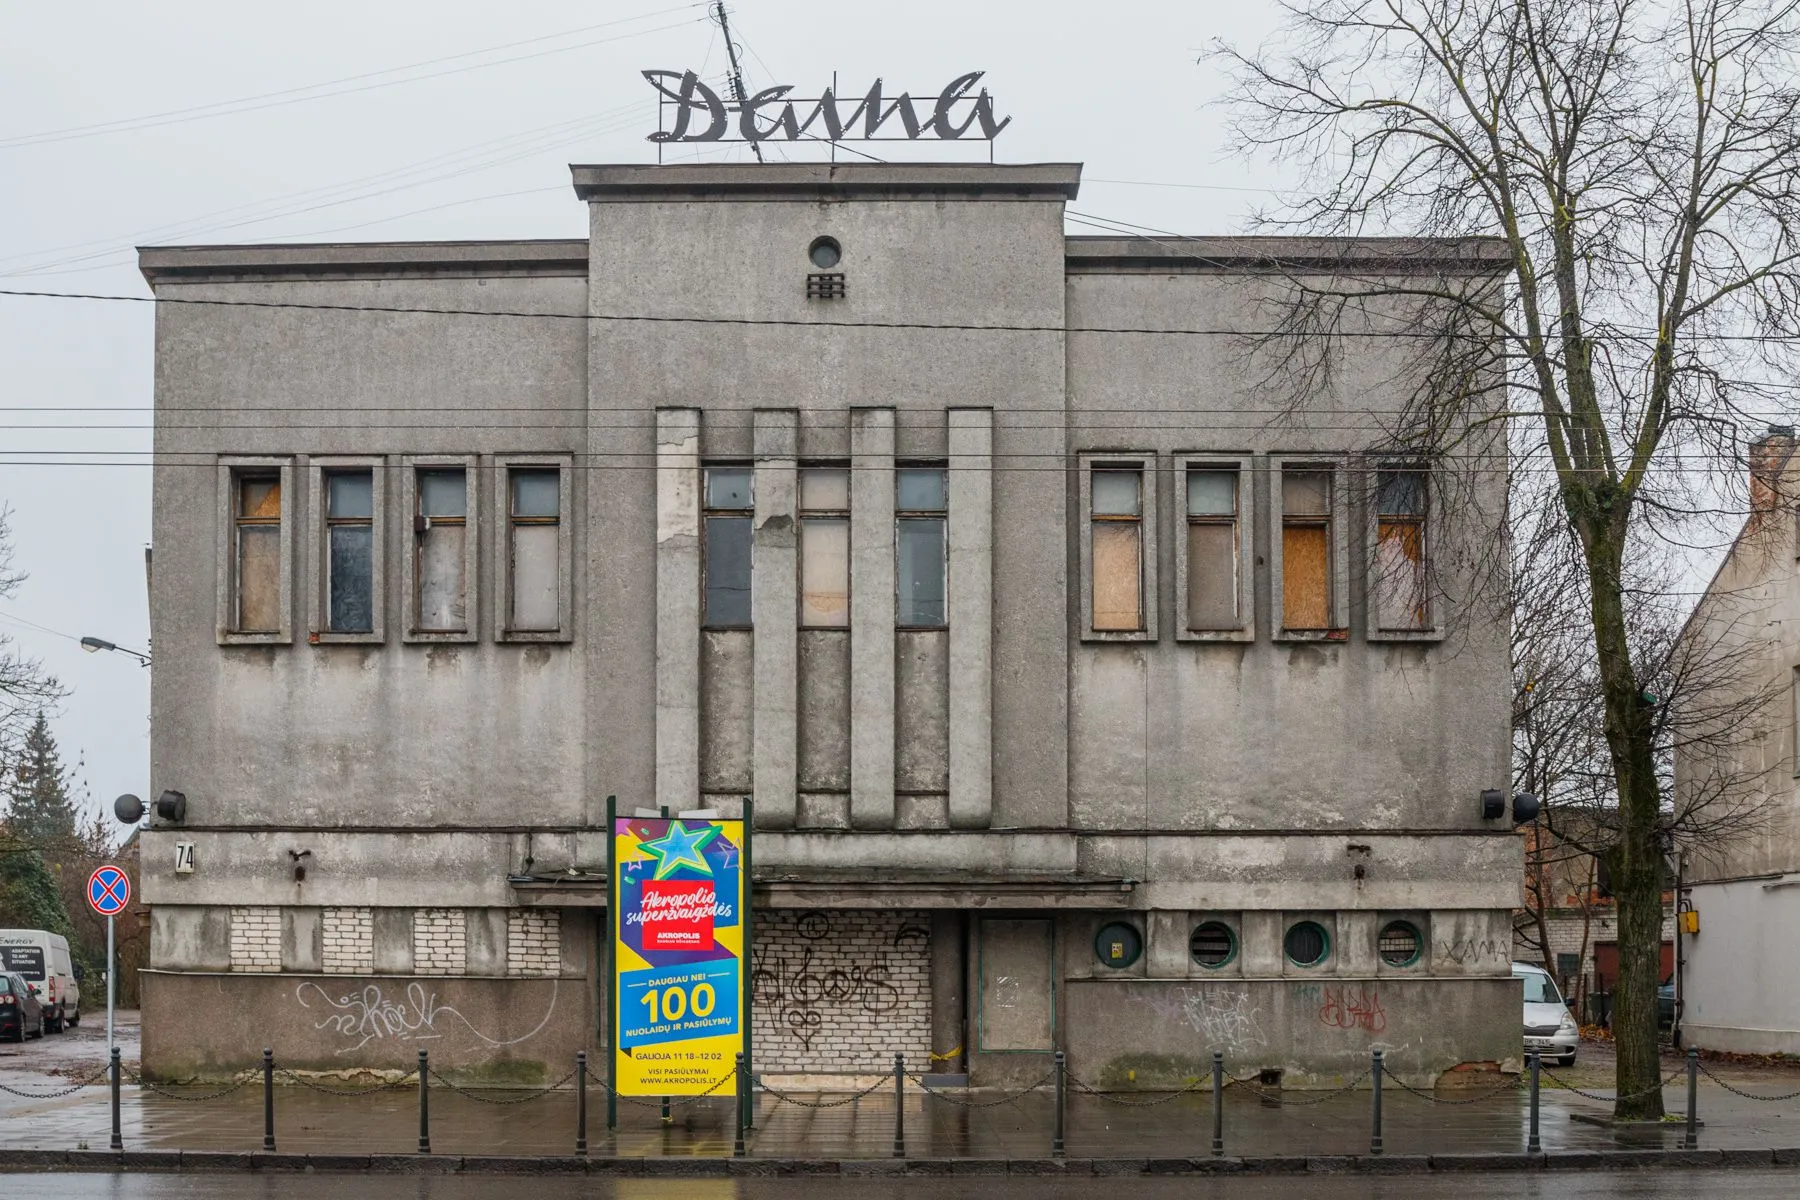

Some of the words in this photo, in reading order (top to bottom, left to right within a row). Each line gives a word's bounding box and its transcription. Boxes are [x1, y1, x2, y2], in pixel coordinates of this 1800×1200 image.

[177, 846, 193, 868] 74
[640, 887, 716, 909] Akropolio
[625, 902, 733, 926] superžvaigždės
[648, 976, 688, 987] DAUGIAU
[640, 982, 716, 1024] 100
[626, 1024, 671, 1037] NUOLAIDŲ
[673, 1022, 682, 1030] IR
[683, 1017, 732, 1030] PASIŪLYMŲ
